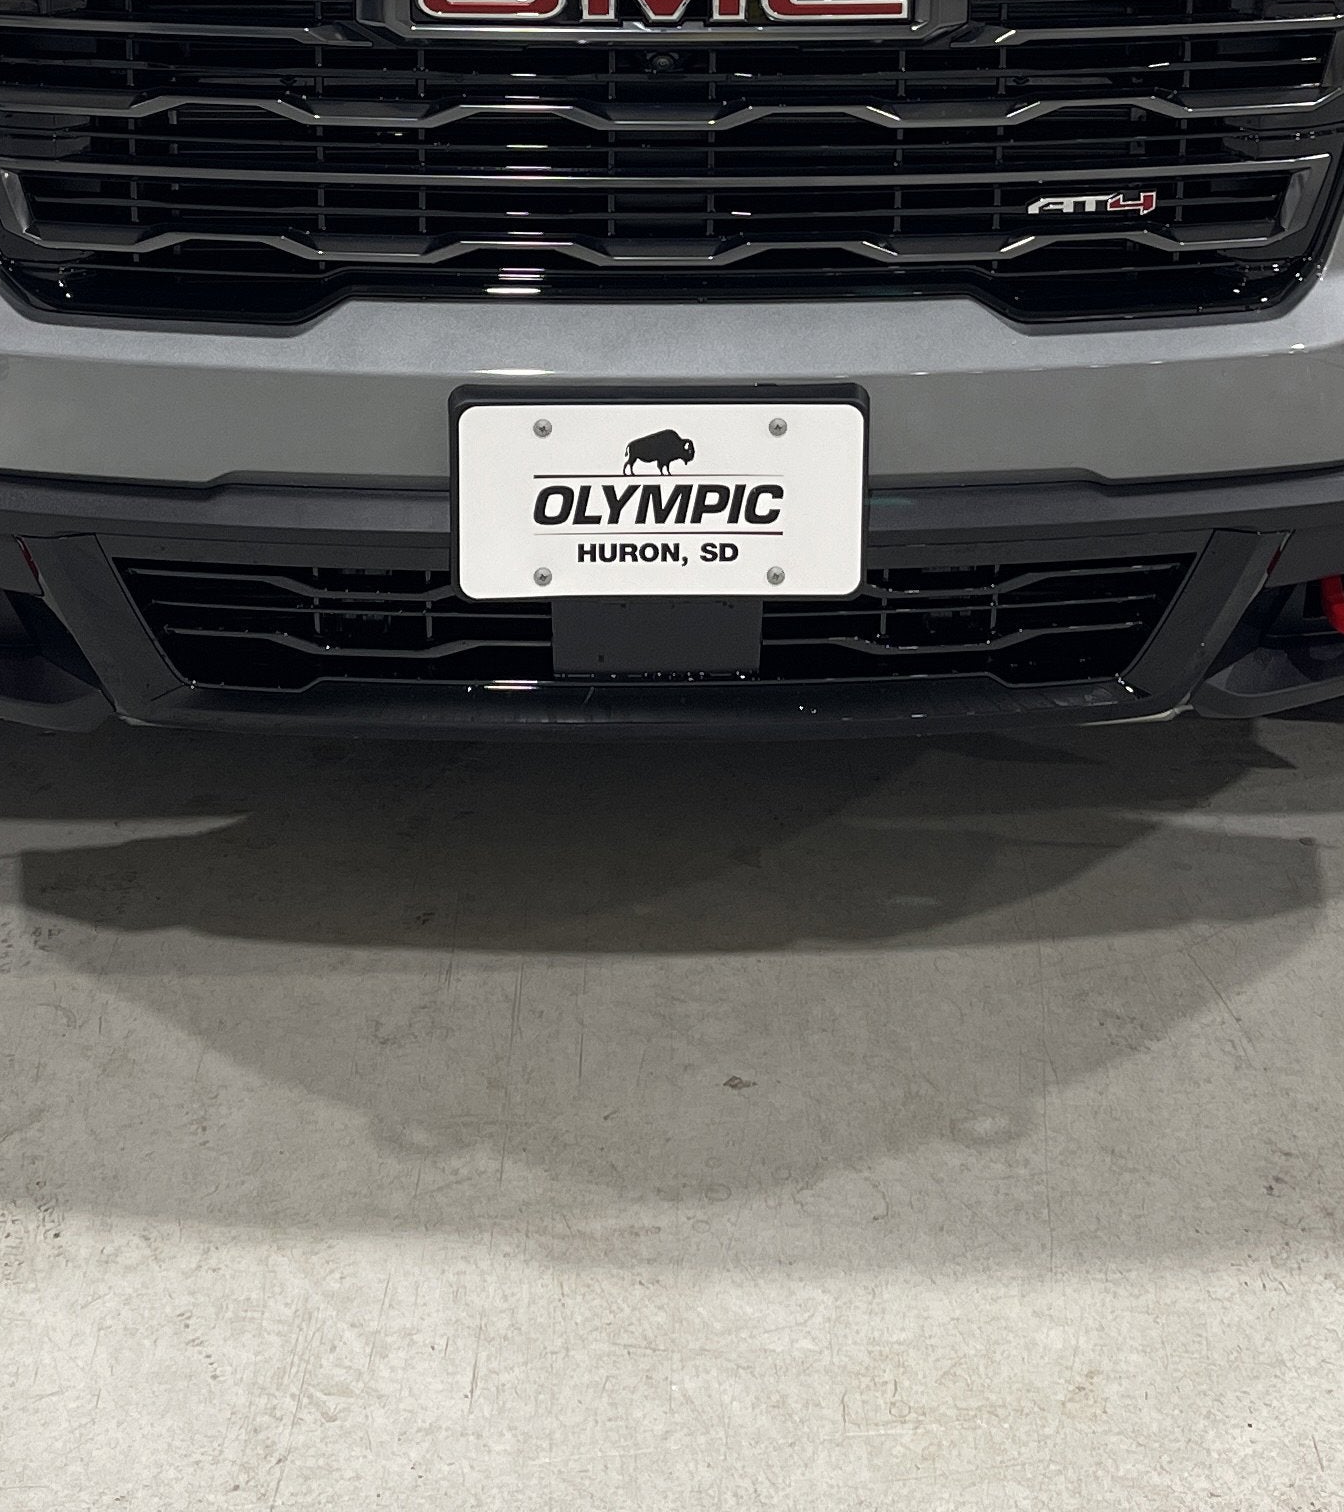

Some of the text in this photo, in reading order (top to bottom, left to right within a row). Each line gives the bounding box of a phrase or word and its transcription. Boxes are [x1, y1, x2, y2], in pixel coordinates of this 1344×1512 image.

[1027, 190, 1157, 217] AT4
[533, 483, 784, 525] OLYMPIC
[577, 543, 739, 566] HURON, SD
